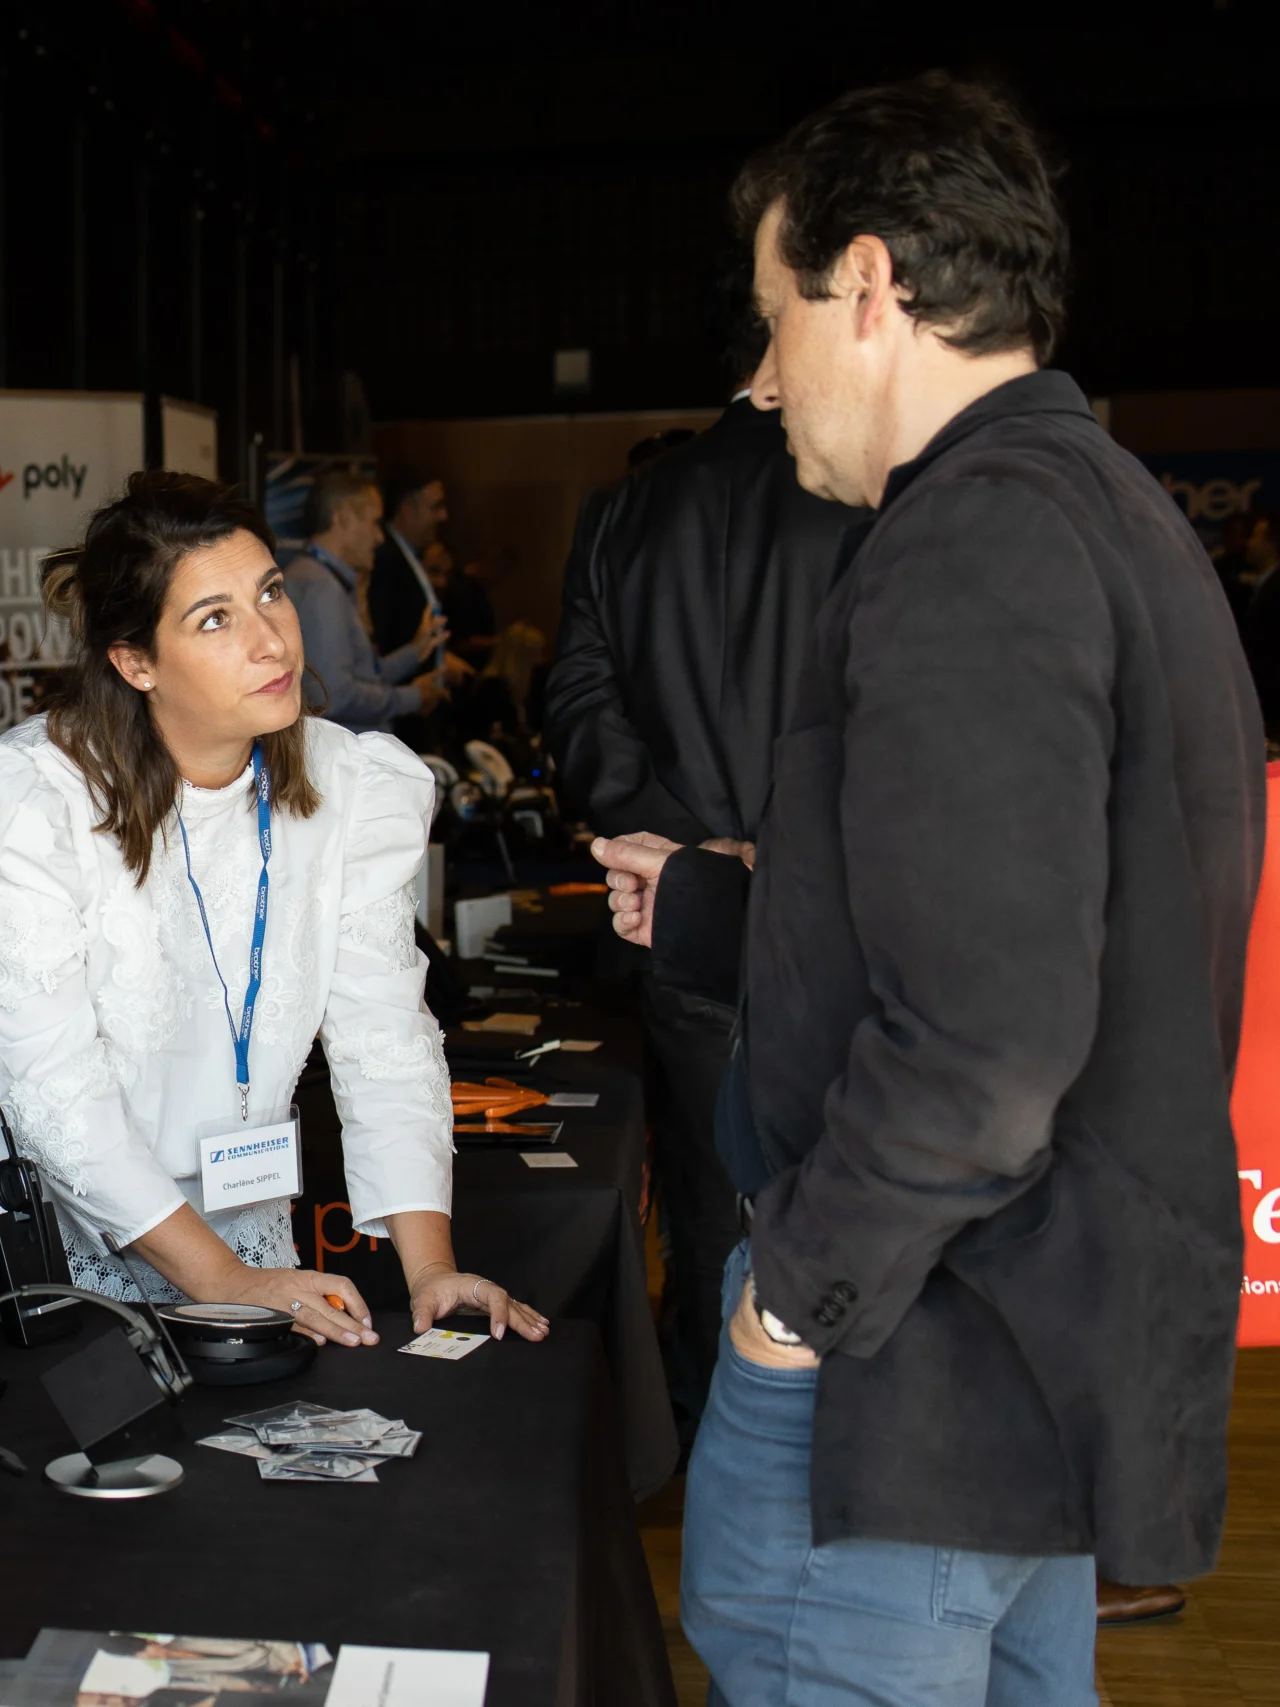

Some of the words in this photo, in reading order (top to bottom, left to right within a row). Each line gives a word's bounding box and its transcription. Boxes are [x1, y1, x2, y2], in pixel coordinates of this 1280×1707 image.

[23, 454, 87, 500] poly
[258, 886, 268, 920] brother
[253, 947, 261, 982] brother
[242, 1006, 252, 1040] brother
[227, 1137, 289, 1155] SENNHEISER
[227, 1143, 289, 1160] COMMUNICATIONS
[222, 1177, 255, 1190] Charlène
[256, 1172, 281, 1184] SIPPEL
